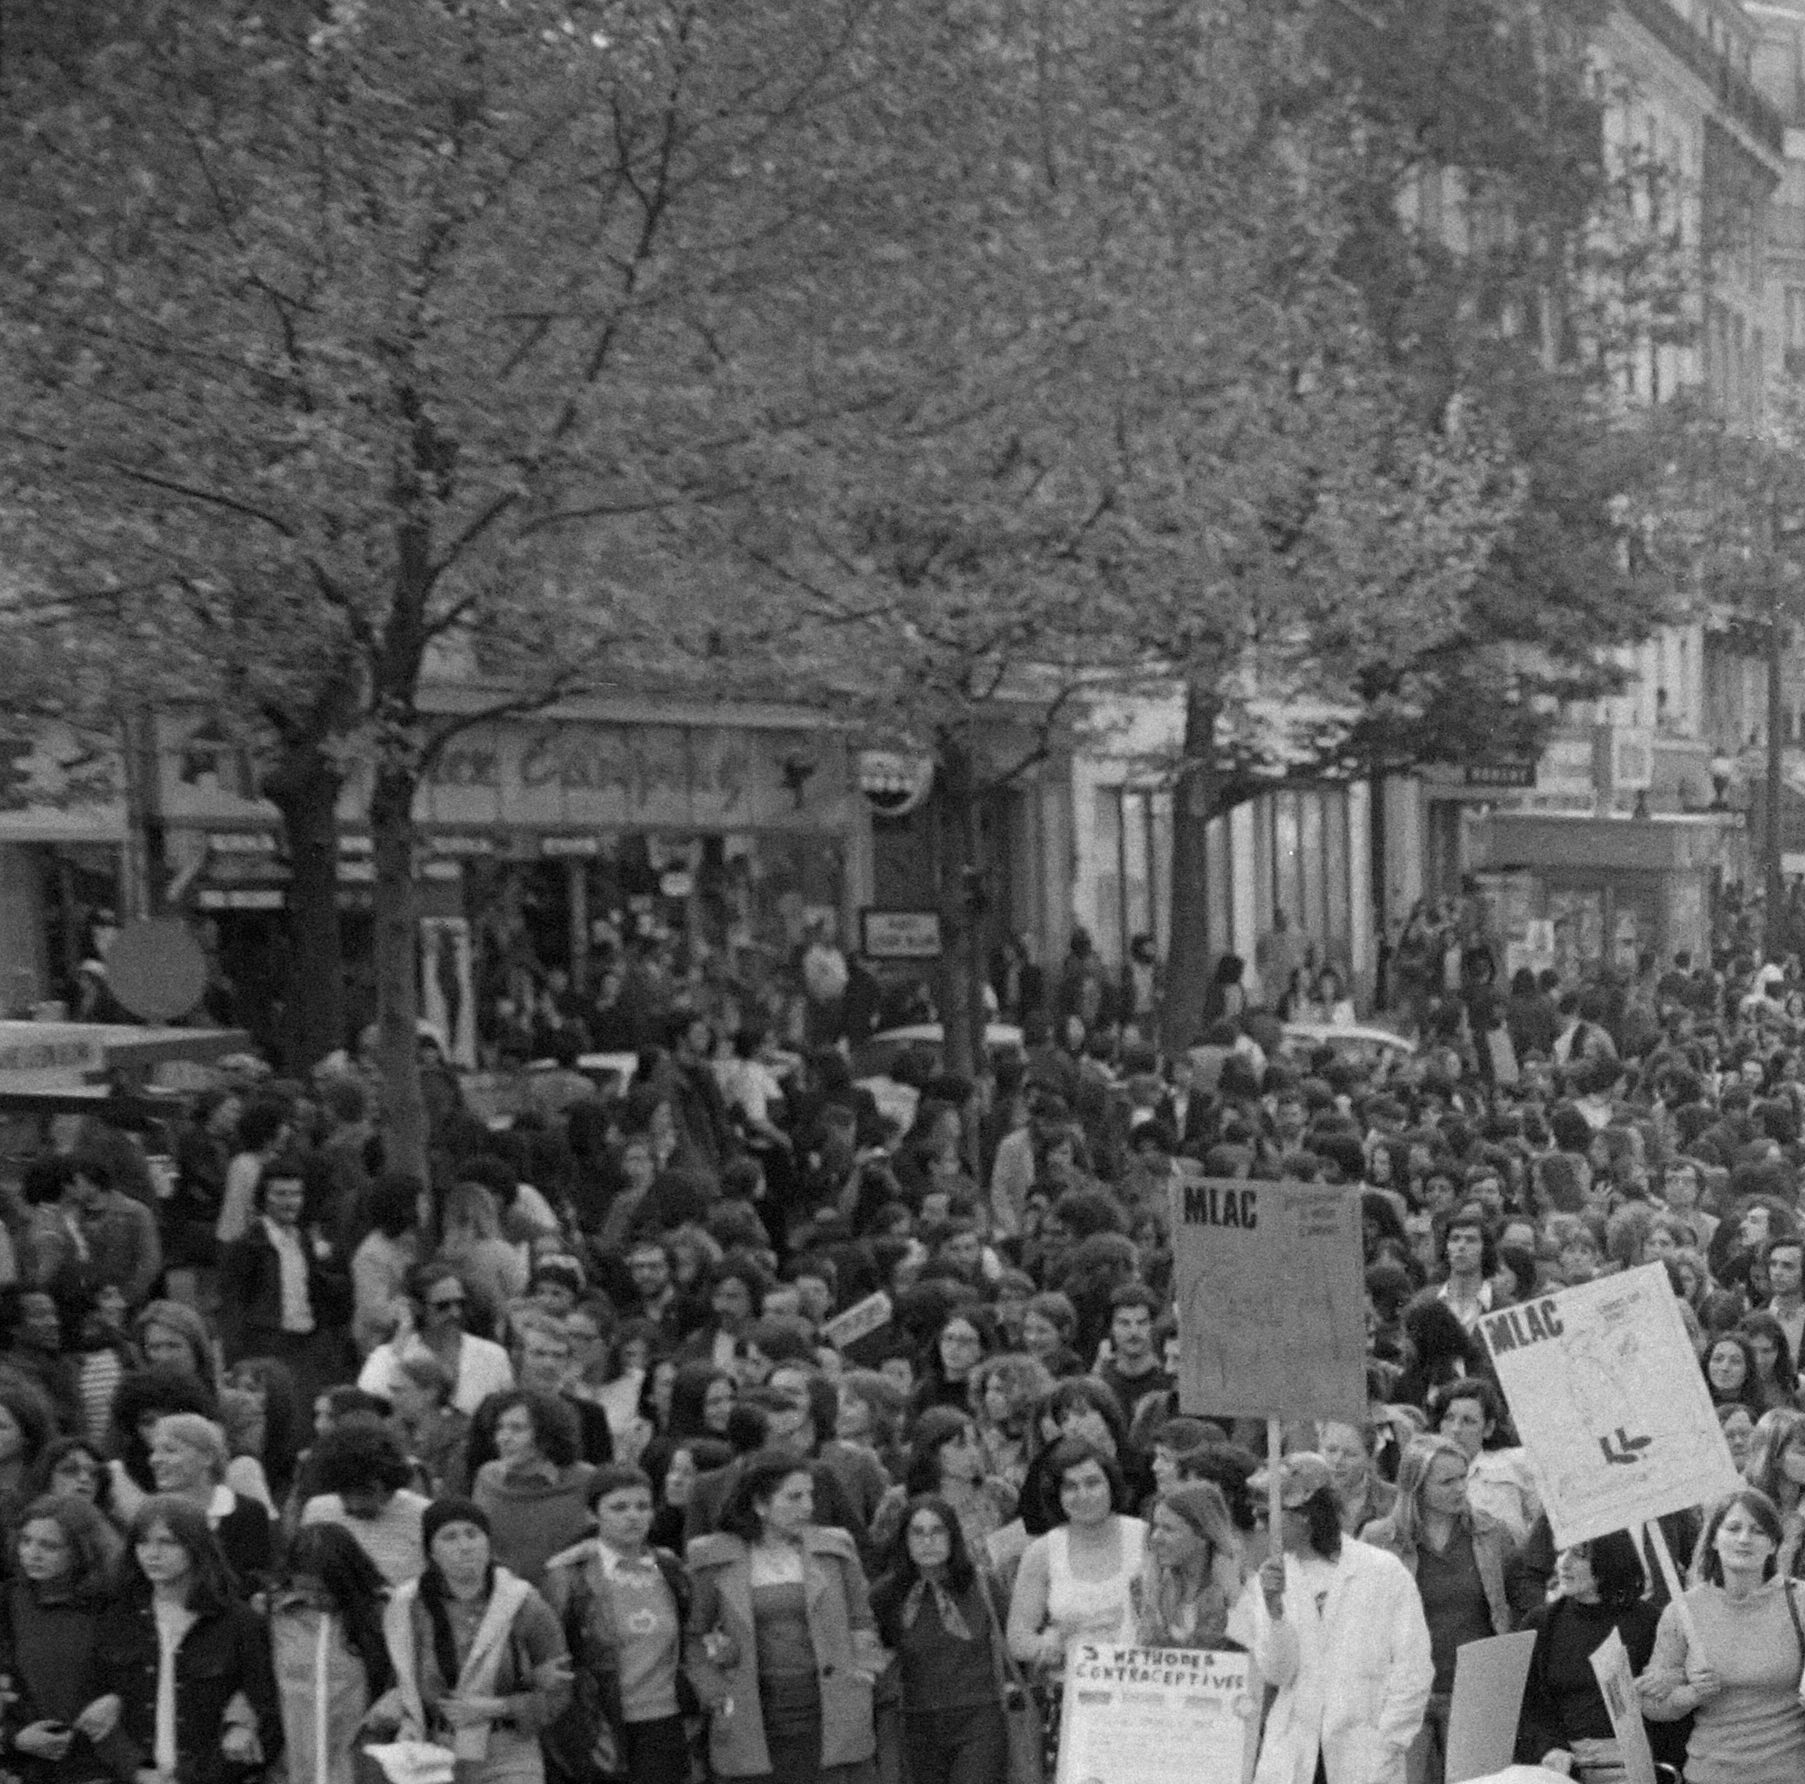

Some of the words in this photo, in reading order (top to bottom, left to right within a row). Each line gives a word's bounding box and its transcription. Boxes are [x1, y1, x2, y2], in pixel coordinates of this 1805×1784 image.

[1183, 1185, 1258, 1230] MLAC
[1483, 1299, 1565, 1356] MLAC
[1075, 1662, 1244, 1689] CONTRACEPTIVES
[1113, 1649, 1215, 1669] METHODES
